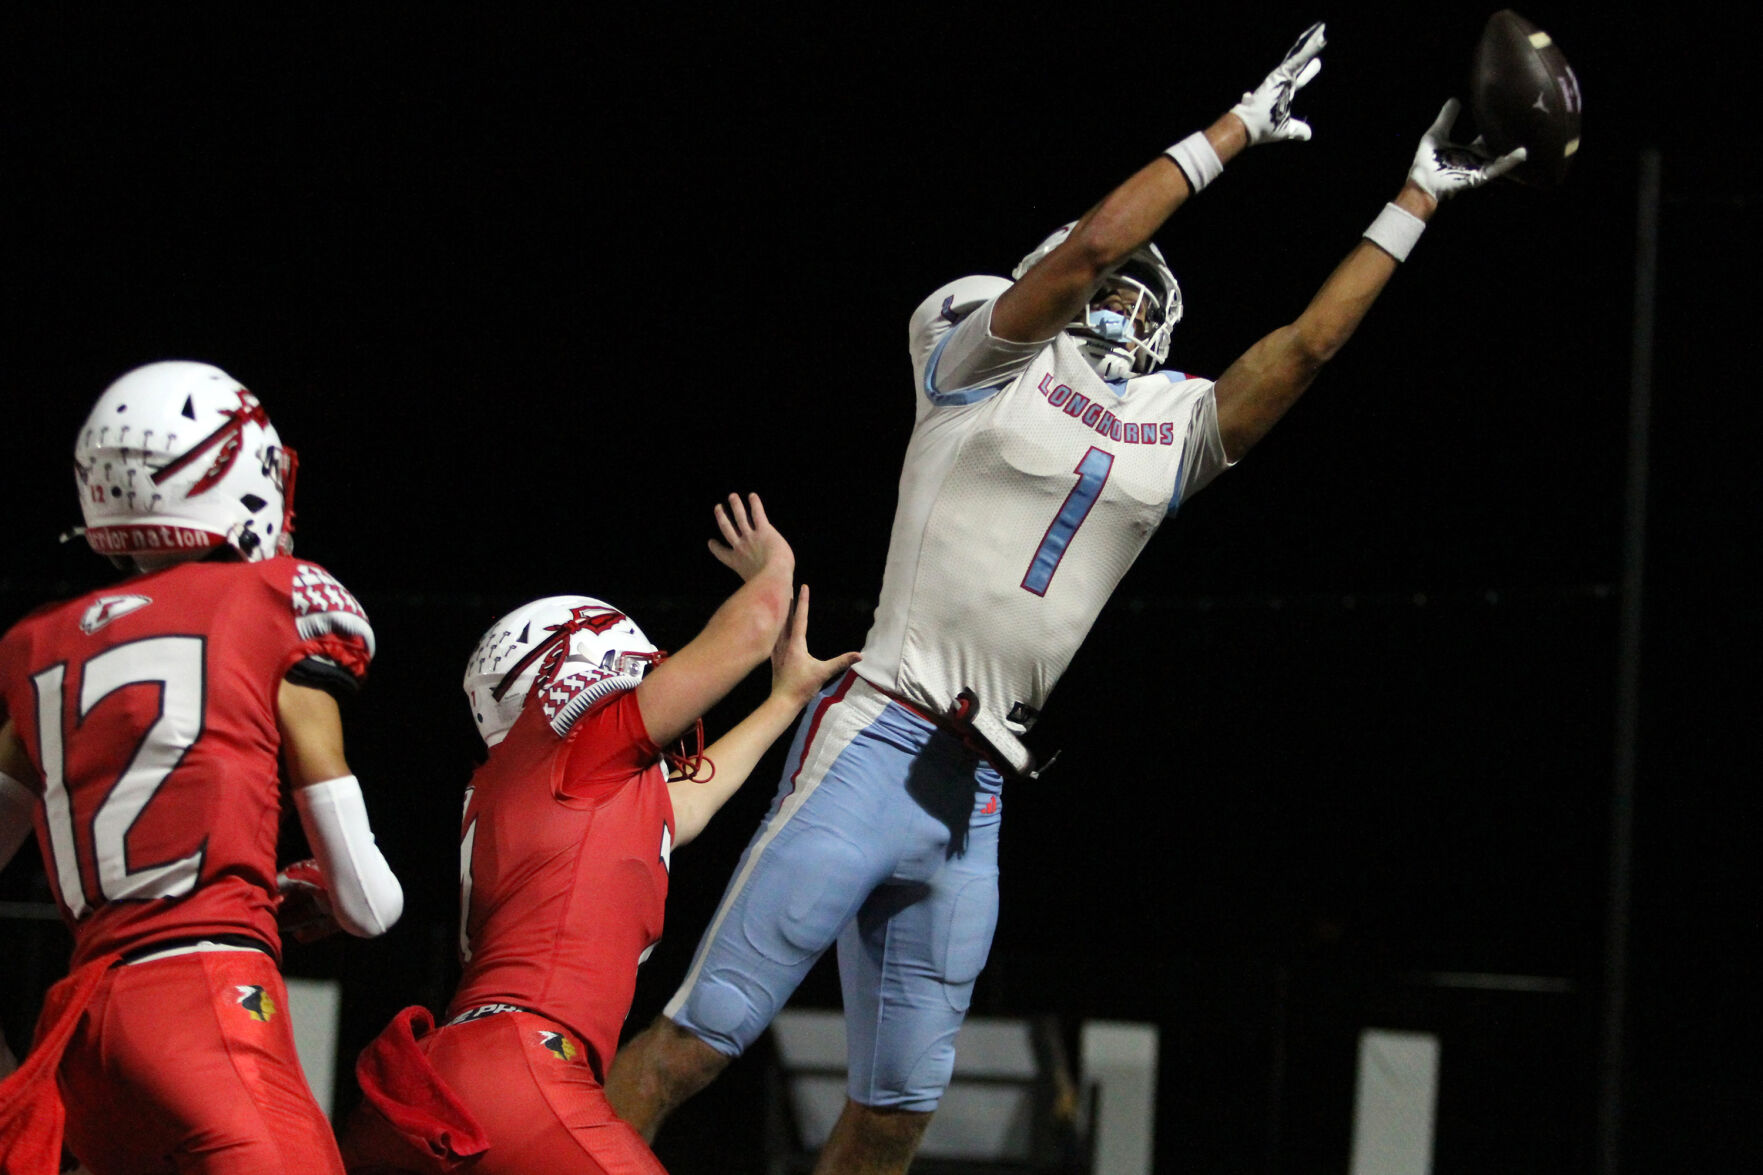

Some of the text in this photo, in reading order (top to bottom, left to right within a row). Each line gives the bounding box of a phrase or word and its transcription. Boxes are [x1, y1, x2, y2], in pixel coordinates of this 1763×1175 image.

[1037, 372, 1174, 446] LONGHORNS
[91, 485, 105, 503] 12
[1020, 446, 1115, 598] 1
[132, 526, 210, 547] nation
[30, 633, 209, 921] 12
